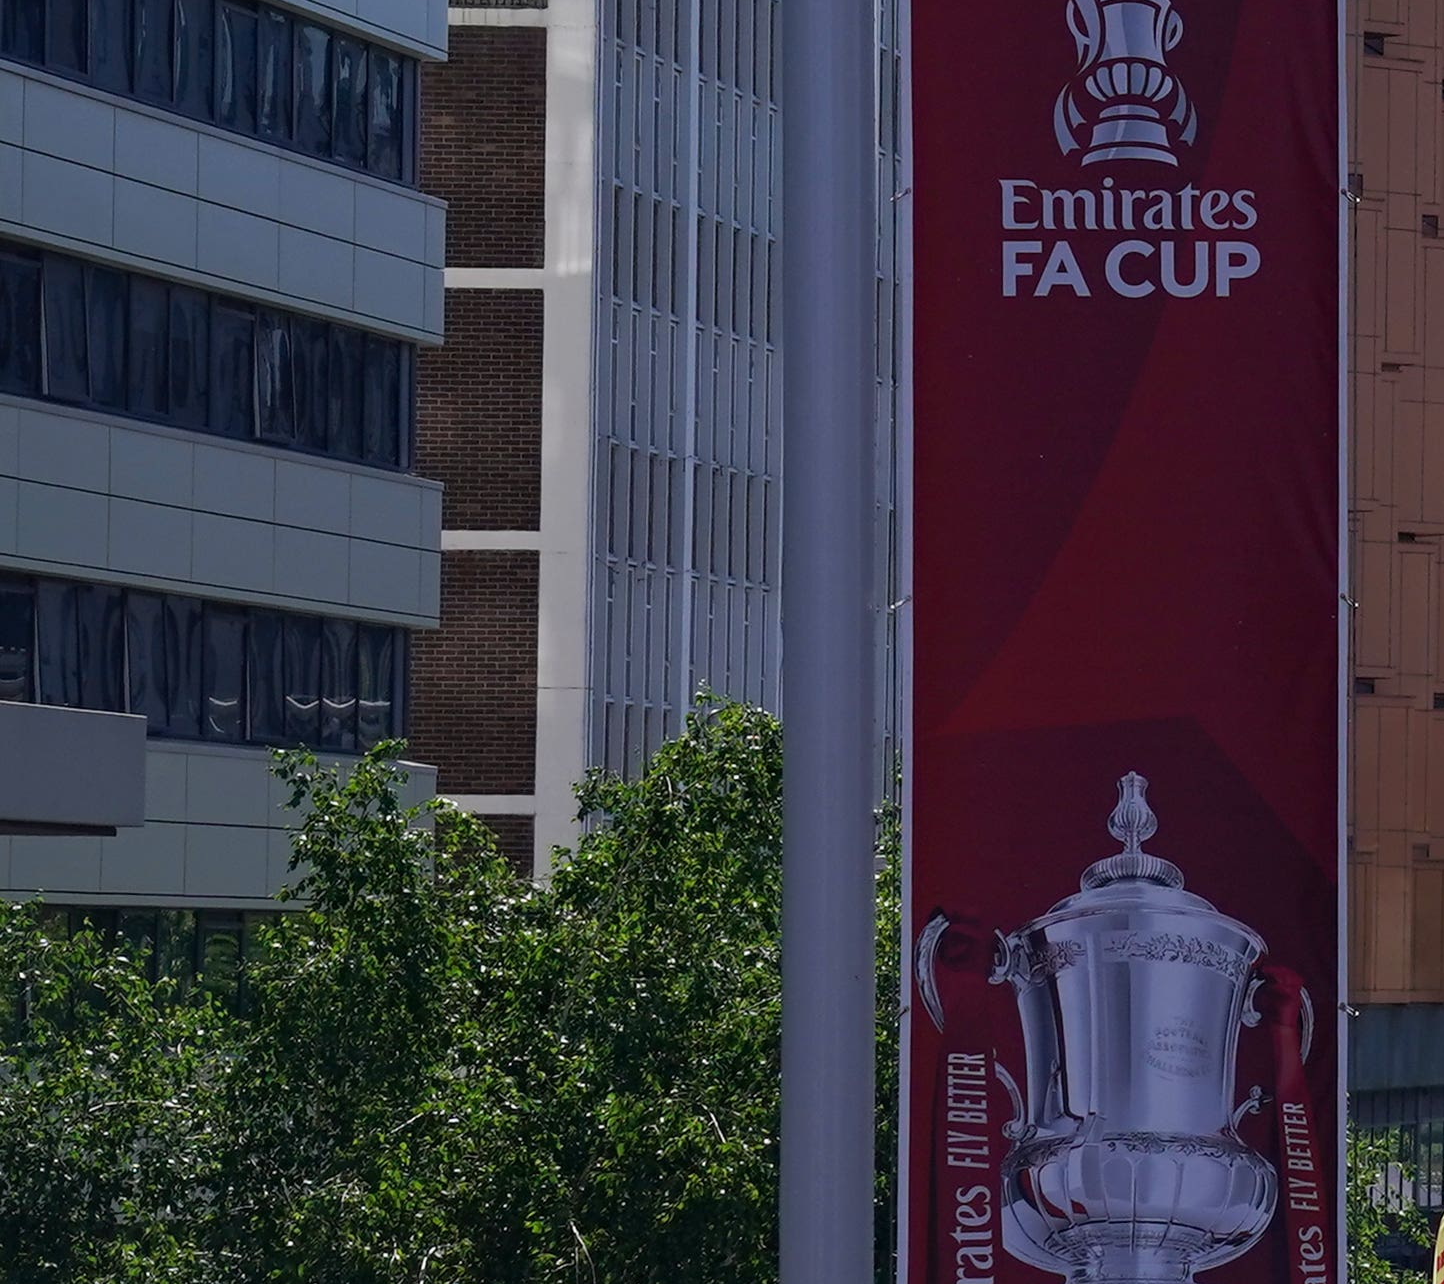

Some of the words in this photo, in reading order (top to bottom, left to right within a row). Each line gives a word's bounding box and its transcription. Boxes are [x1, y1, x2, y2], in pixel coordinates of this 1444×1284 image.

[1000, 177, 1258, 231] Emirates
[1002, 241, 1091, 297] FA
[1104, 240, 1262, 298] CUP
[947, 1051, 987, 1124] BETTER
[947, 1128, 988, 1171] FLY
[1281, 1100, 1316, 1172] BETTER
[1288, 1170, 1322, 1213] FLY
